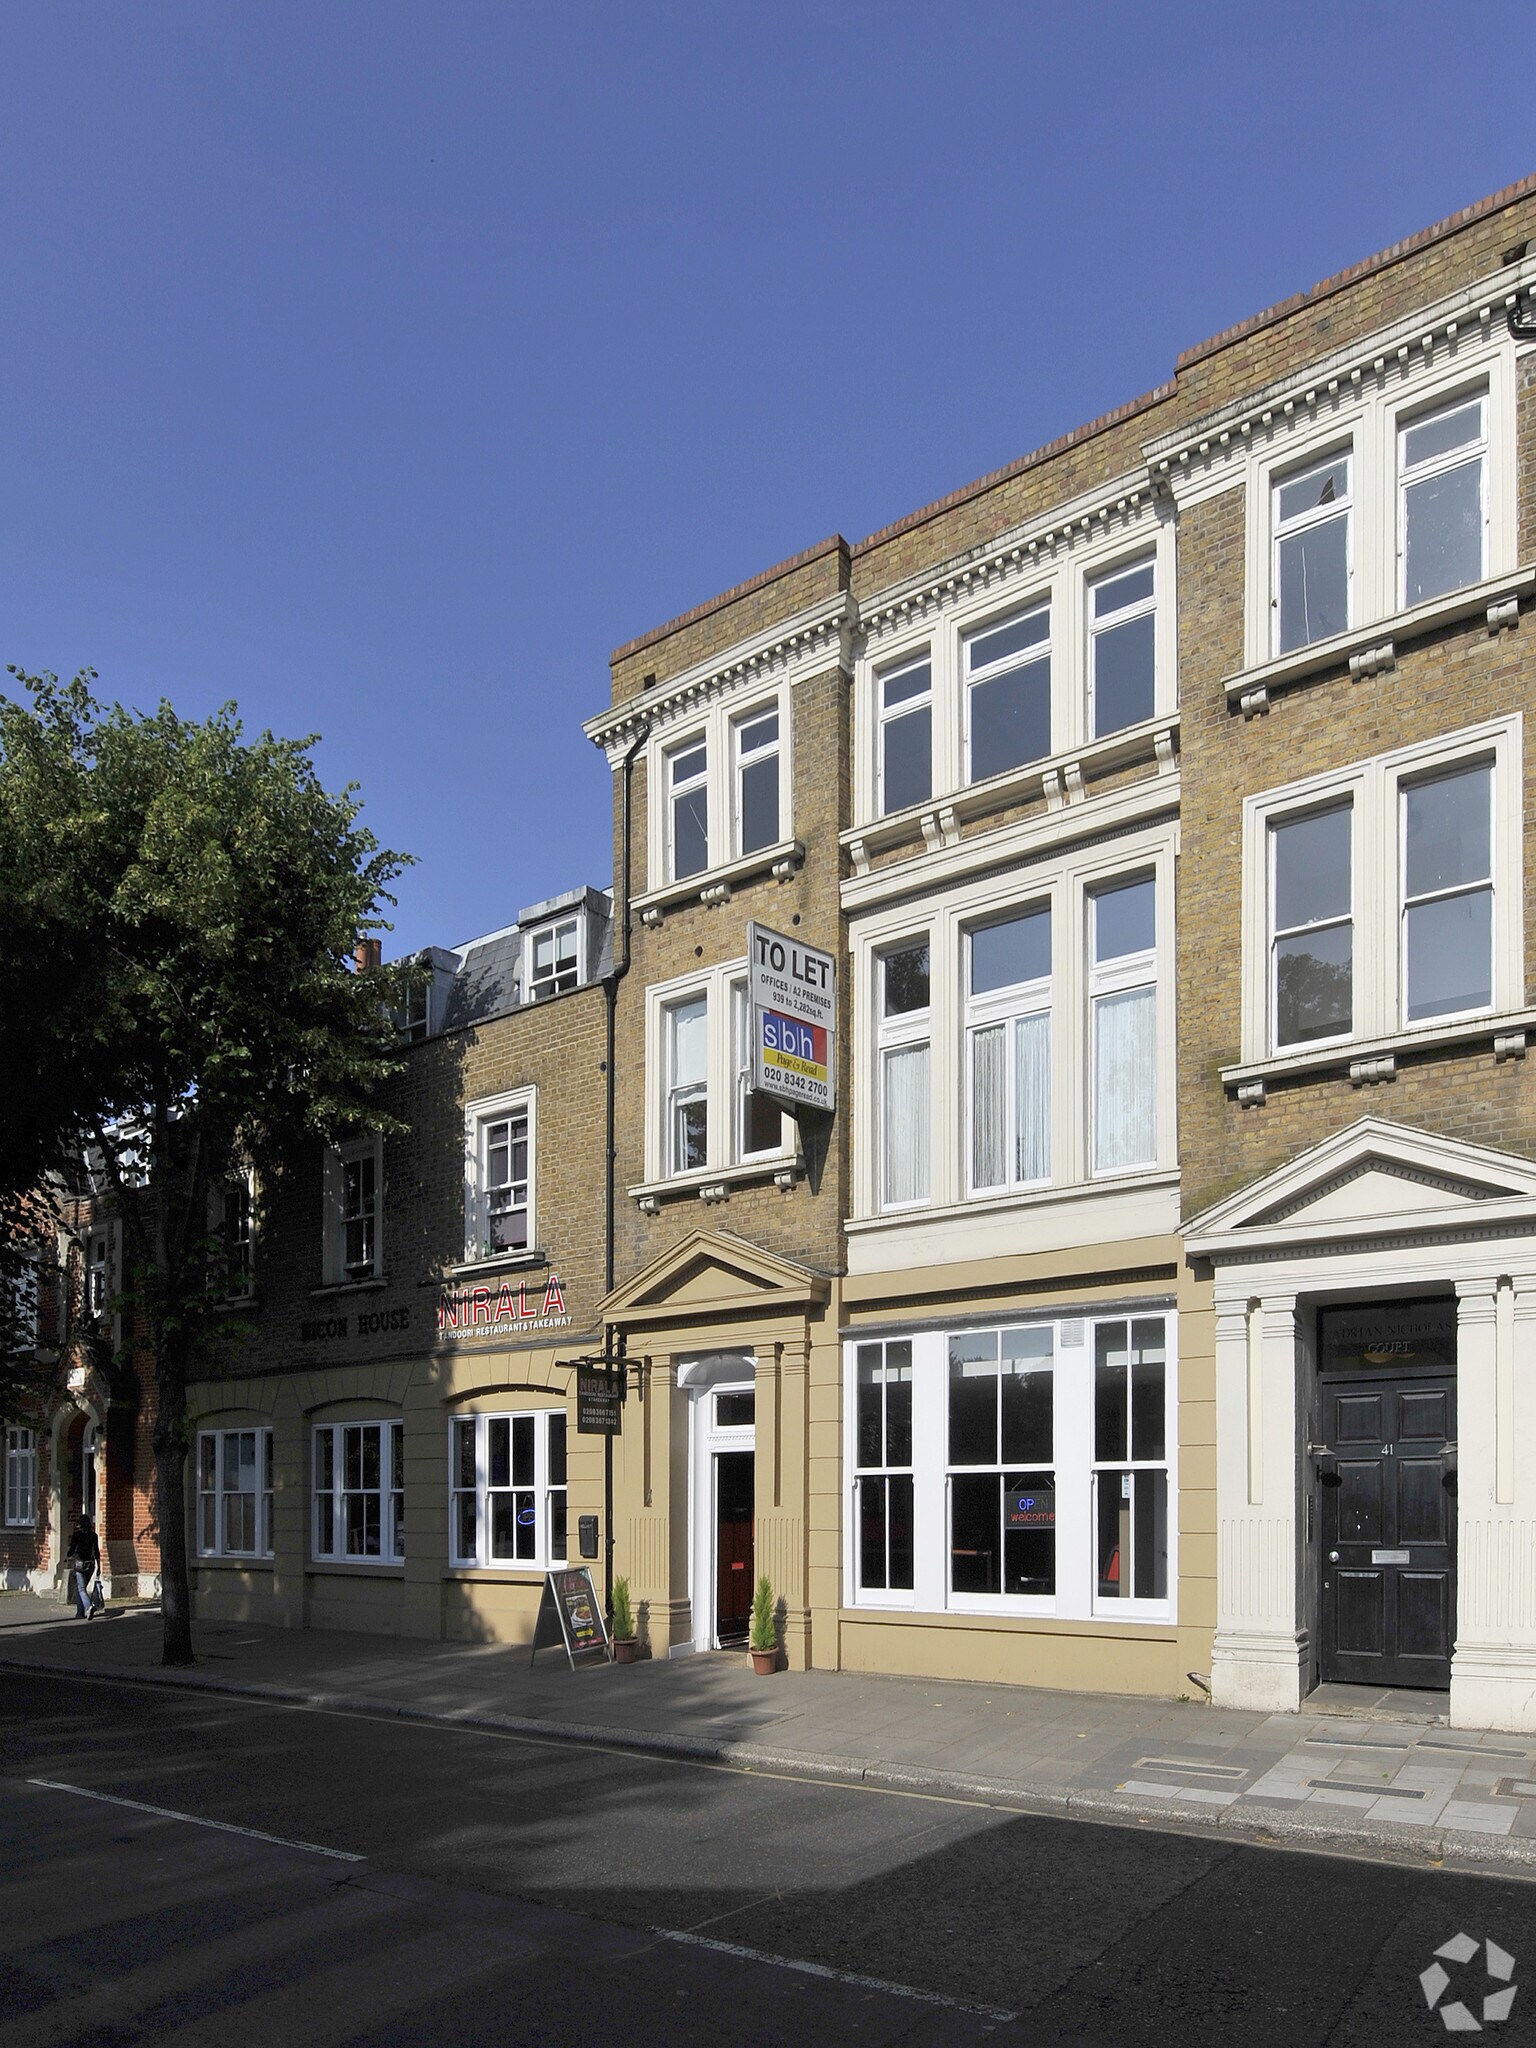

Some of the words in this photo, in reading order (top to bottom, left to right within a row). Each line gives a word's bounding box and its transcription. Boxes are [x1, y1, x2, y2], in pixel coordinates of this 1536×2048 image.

[757, 935, 785, 973] TO
[792, 950, 829, 989] LET
[761, 974, 788, 992] OFFICES
[793, 986, 801, 997] A2
[802, 989, 831, 1009] PREMISES
[773, 991, 784, 1004] 939
[786, 997, 792, 1006] to
[776, 1053, 792, 1068] Page
[793, 1059, 800, 1070] &
[801, 1061, 817, 1076] Read
[764, 1067, 781, 1082] 020
[785, 1073, 805, 1089] 8342
[808, 1080, 828, 1096] 2700
[439, 1275, 566, 1329] NIRALA
[358, 1308, 410, 1335] HOUSE
[439, 1329, 474, 1341] TANDOORI
[529, 1316, 573, 1330] TAKEAWAY
[580, 1378, 618, 1394] NIRALA
[1381, 1444, 1394, 1455] 41
[1011, 1511, 1055, 1522] welcome
